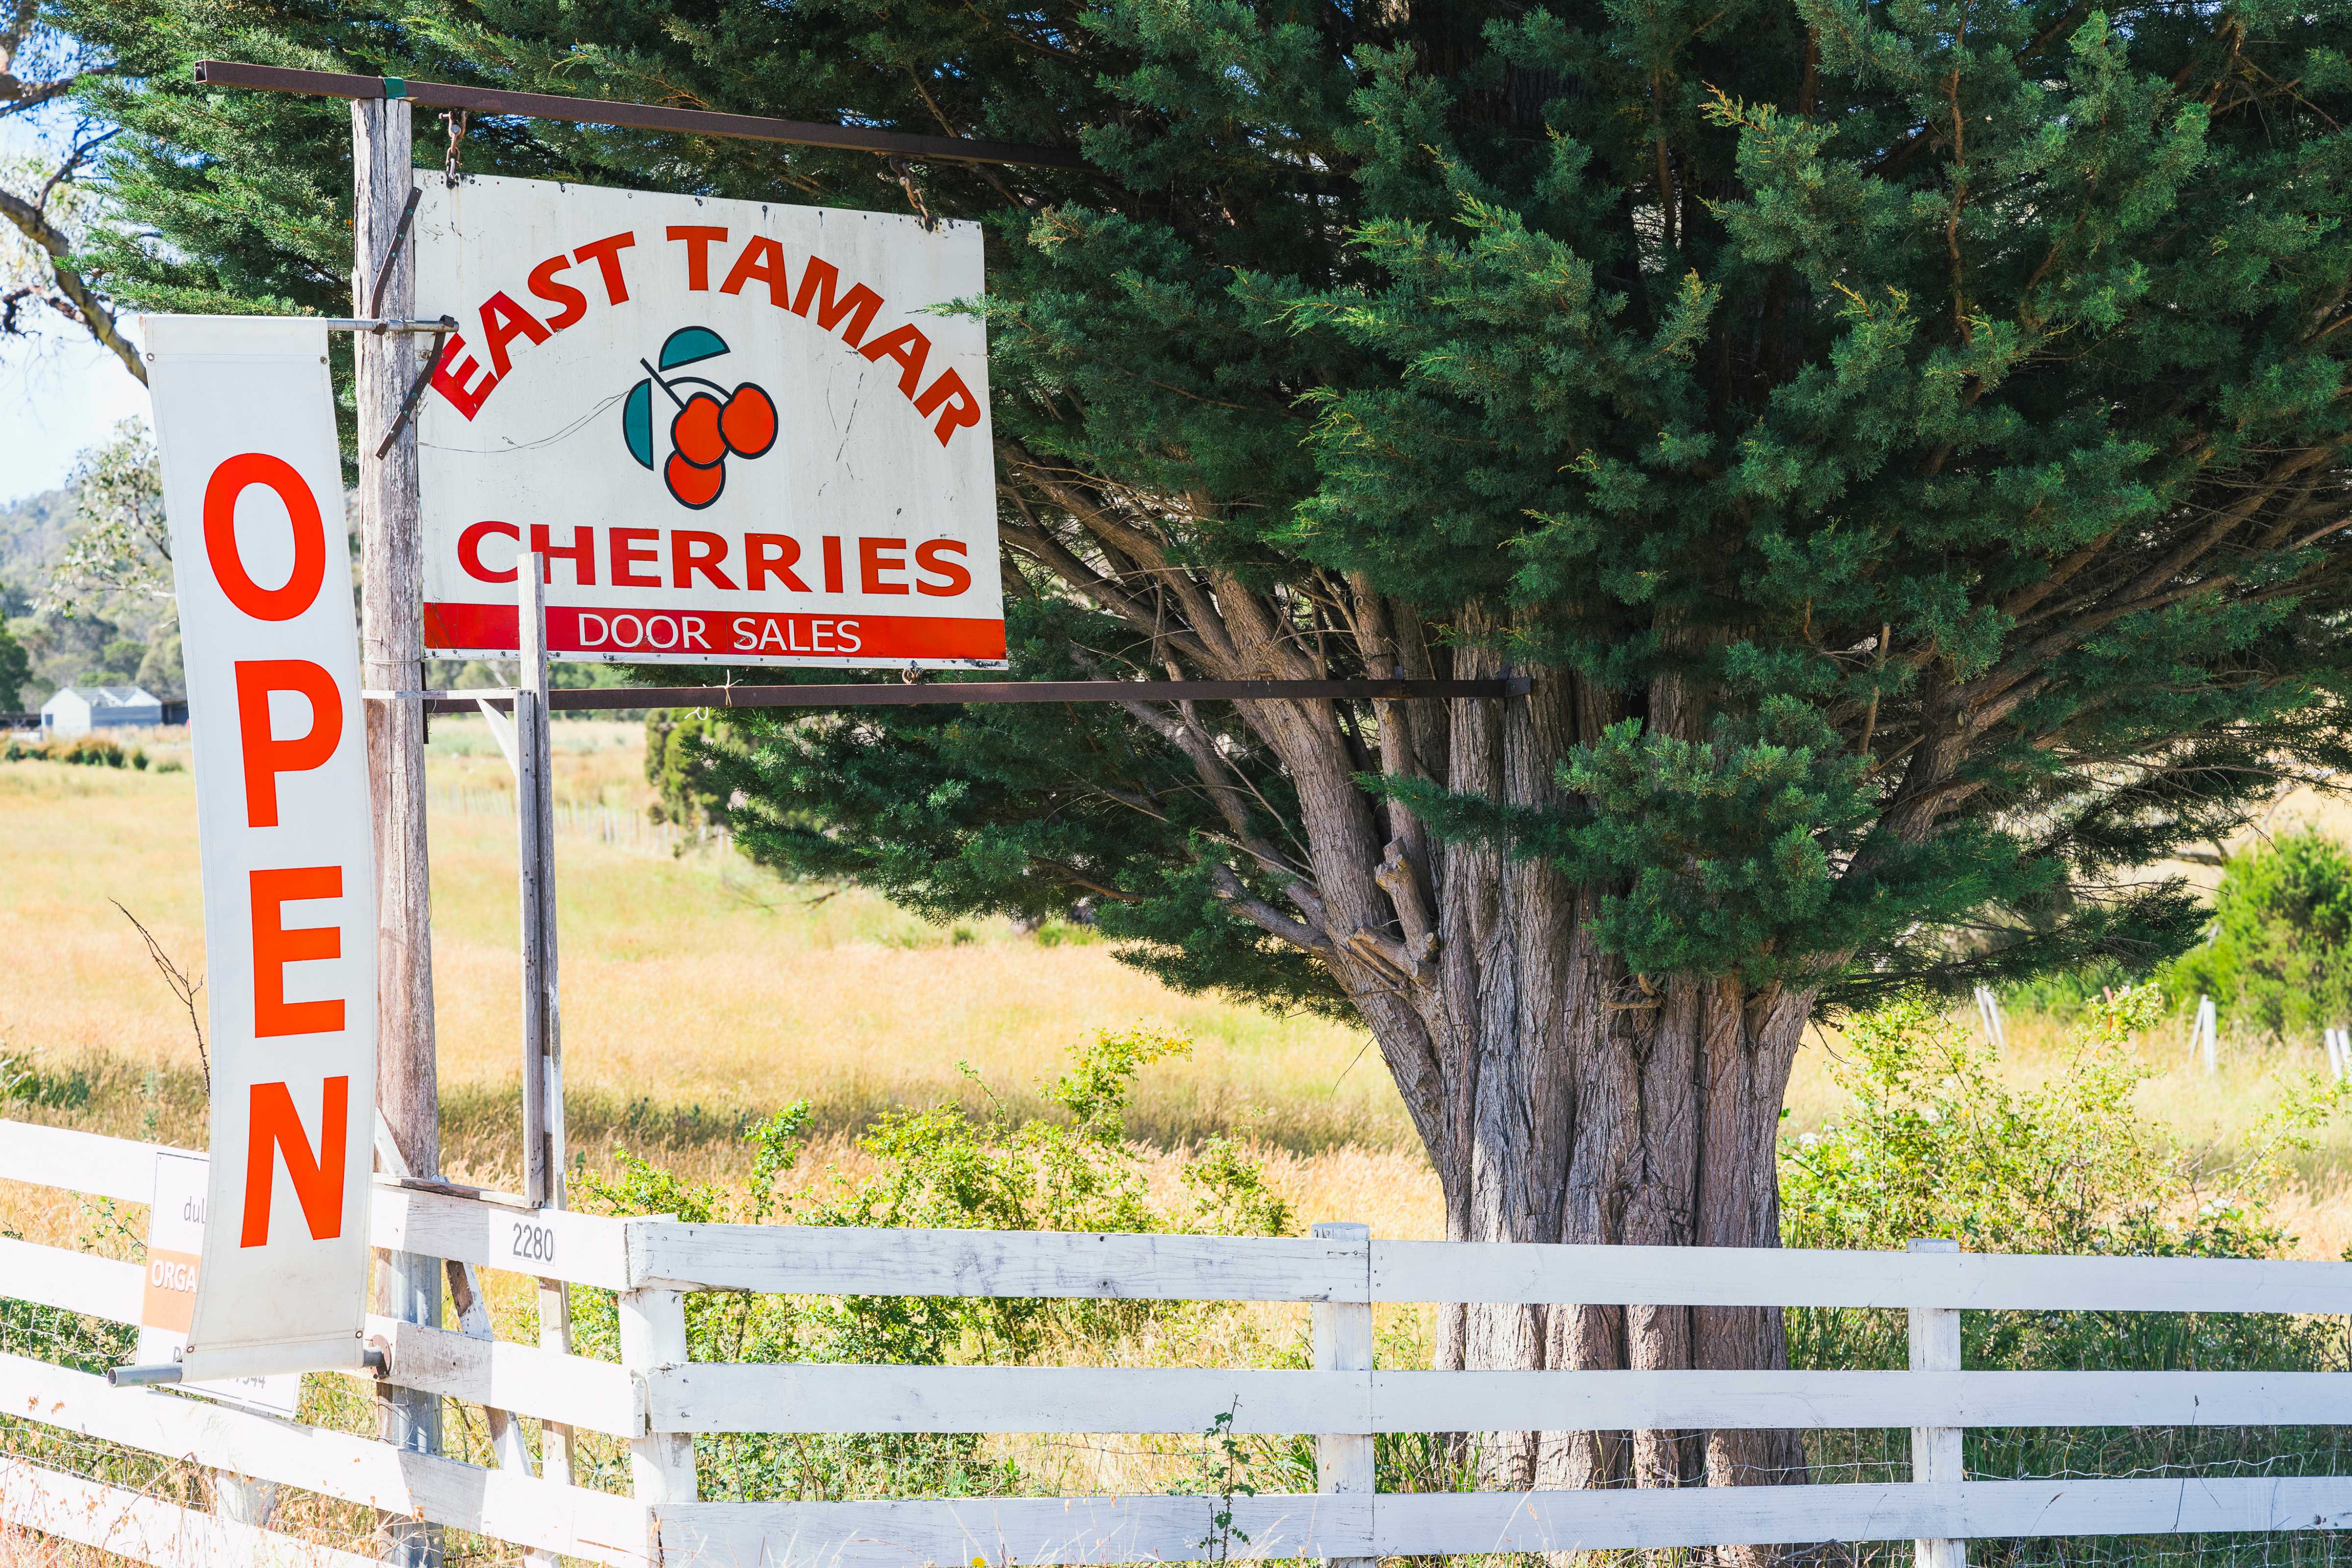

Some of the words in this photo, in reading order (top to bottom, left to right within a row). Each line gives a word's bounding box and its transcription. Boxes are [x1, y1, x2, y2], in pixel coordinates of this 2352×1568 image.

[430, 231, 636, 421] EAST
[666, 225, 980, 446] TAMAR
[457, 521, 971, 597] CHERRIES
[578, 613, 712, 649] DOOR
[732, 617, 861, 652] SALES
[203, 452, 349, 1249] OPEN
[513, 1222, 554, 1263] 2280
